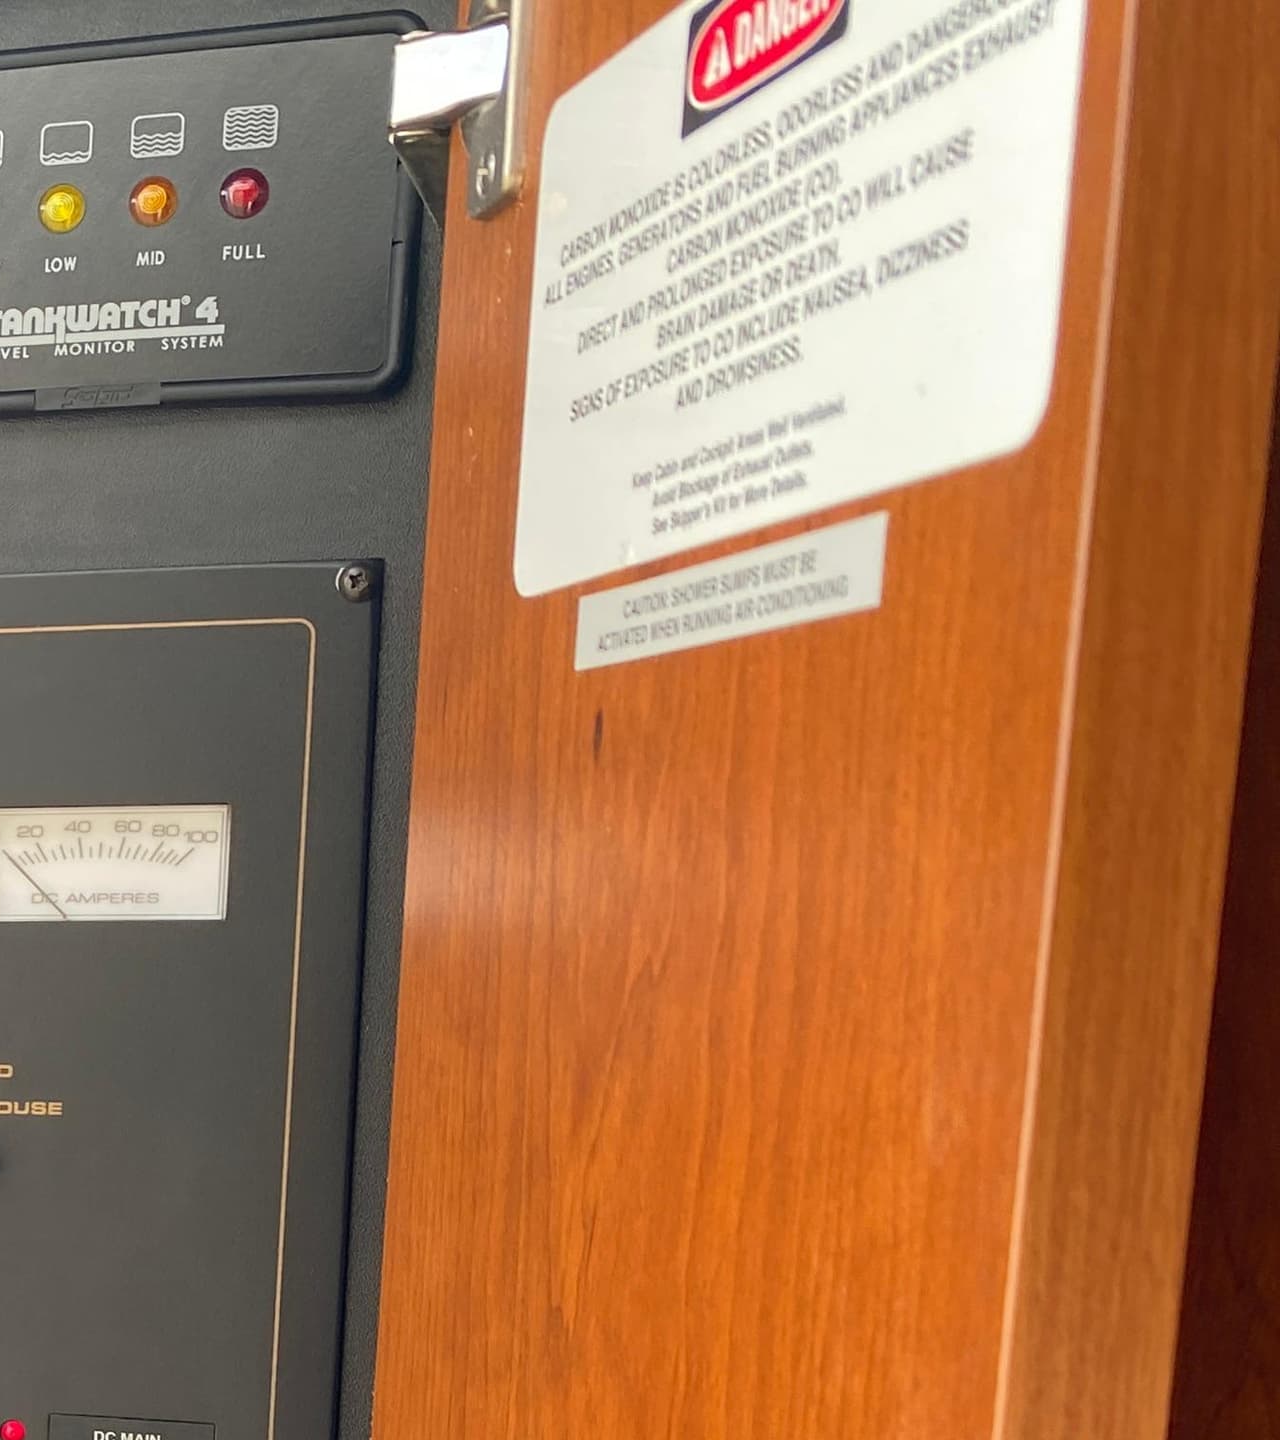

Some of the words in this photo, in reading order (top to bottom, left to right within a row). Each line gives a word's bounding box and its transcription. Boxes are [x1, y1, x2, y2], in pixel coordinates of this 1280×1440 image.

[560, 222, 606, 268] CARBON
[609, 181, 671, 238] MONOXIDE
[674, 174, 685, 197] IS
[667, 225, 722, 273] CARBON
[725, 178, 802, 242] MONOXIDE
[45, 257, 76, 272] LOW
[137, 251, 164, 266] MID
[223, 244, 265, 260] FULL
[196, 297, 218, 323] 4
[657, 312, 695, 349] BRAIN
[699, 277, 758, 329] DAMAGE
[761, 268, 782, 299] OR
[54, 341, 134, 356] MONITOR
[161, 336, 222, 350] SYSTEM
[677, 379, 702, 408] AND
[17, 825, 44, 838] 20
[64, 821, 91, 833] 40
[115, 820, 142, 832] 60
[152, 824, 180, 837] 80
[184, 831, 218, 843] 100
[30, 892, 59, 905] DC
[65, 893, 159, 904] AMPERES
